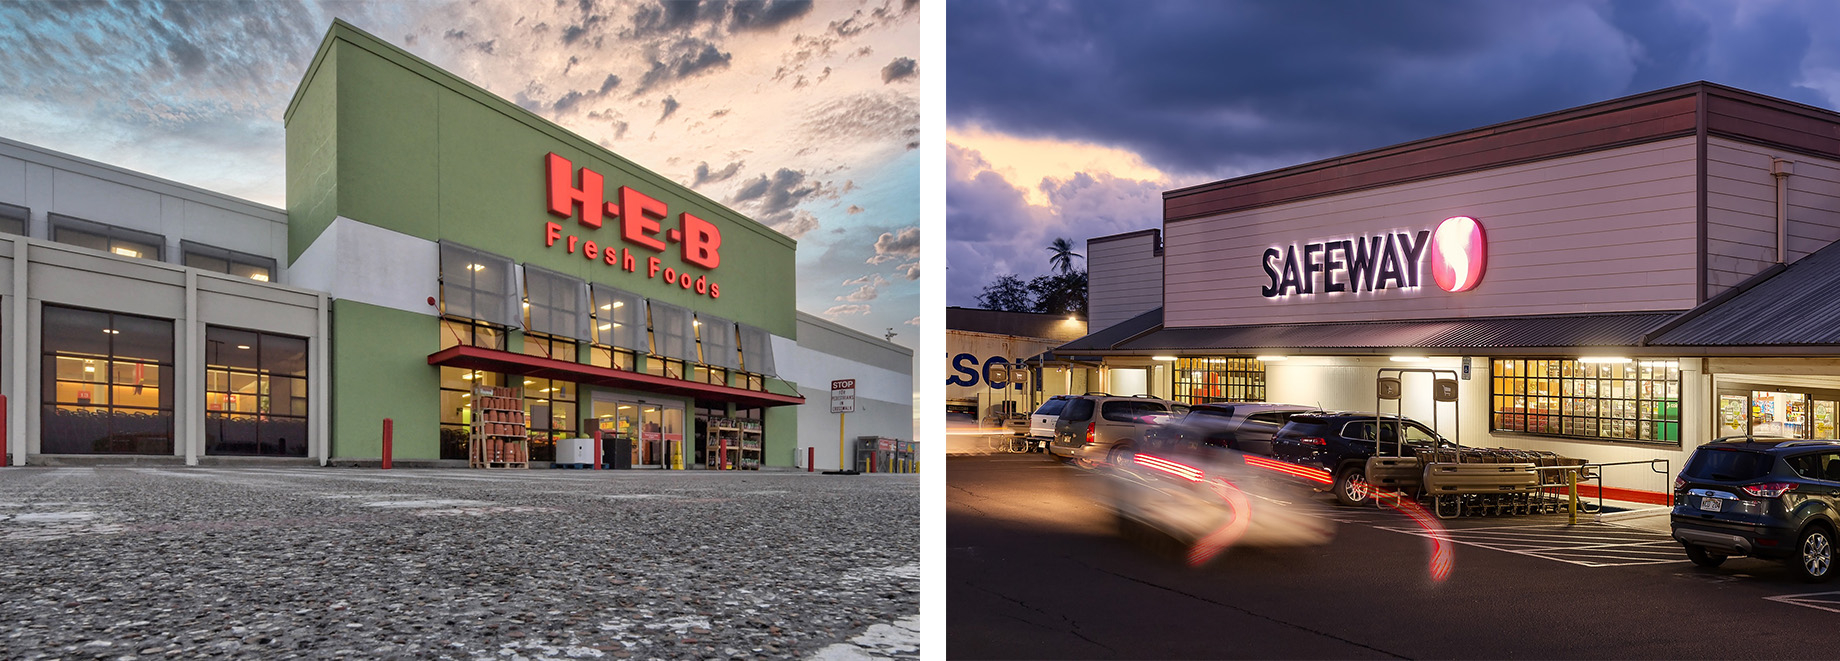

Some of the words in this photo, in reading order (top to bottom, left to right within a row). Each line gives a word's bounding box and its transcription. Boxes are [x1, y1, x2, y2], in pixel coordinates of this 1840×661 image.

[545, 221, 635, 272] Fresh
[648, 256, 720, 298] Foods
[1262, 230, 1430, 297] SAFEWAY
[832, 380, 853, 389] STOP
